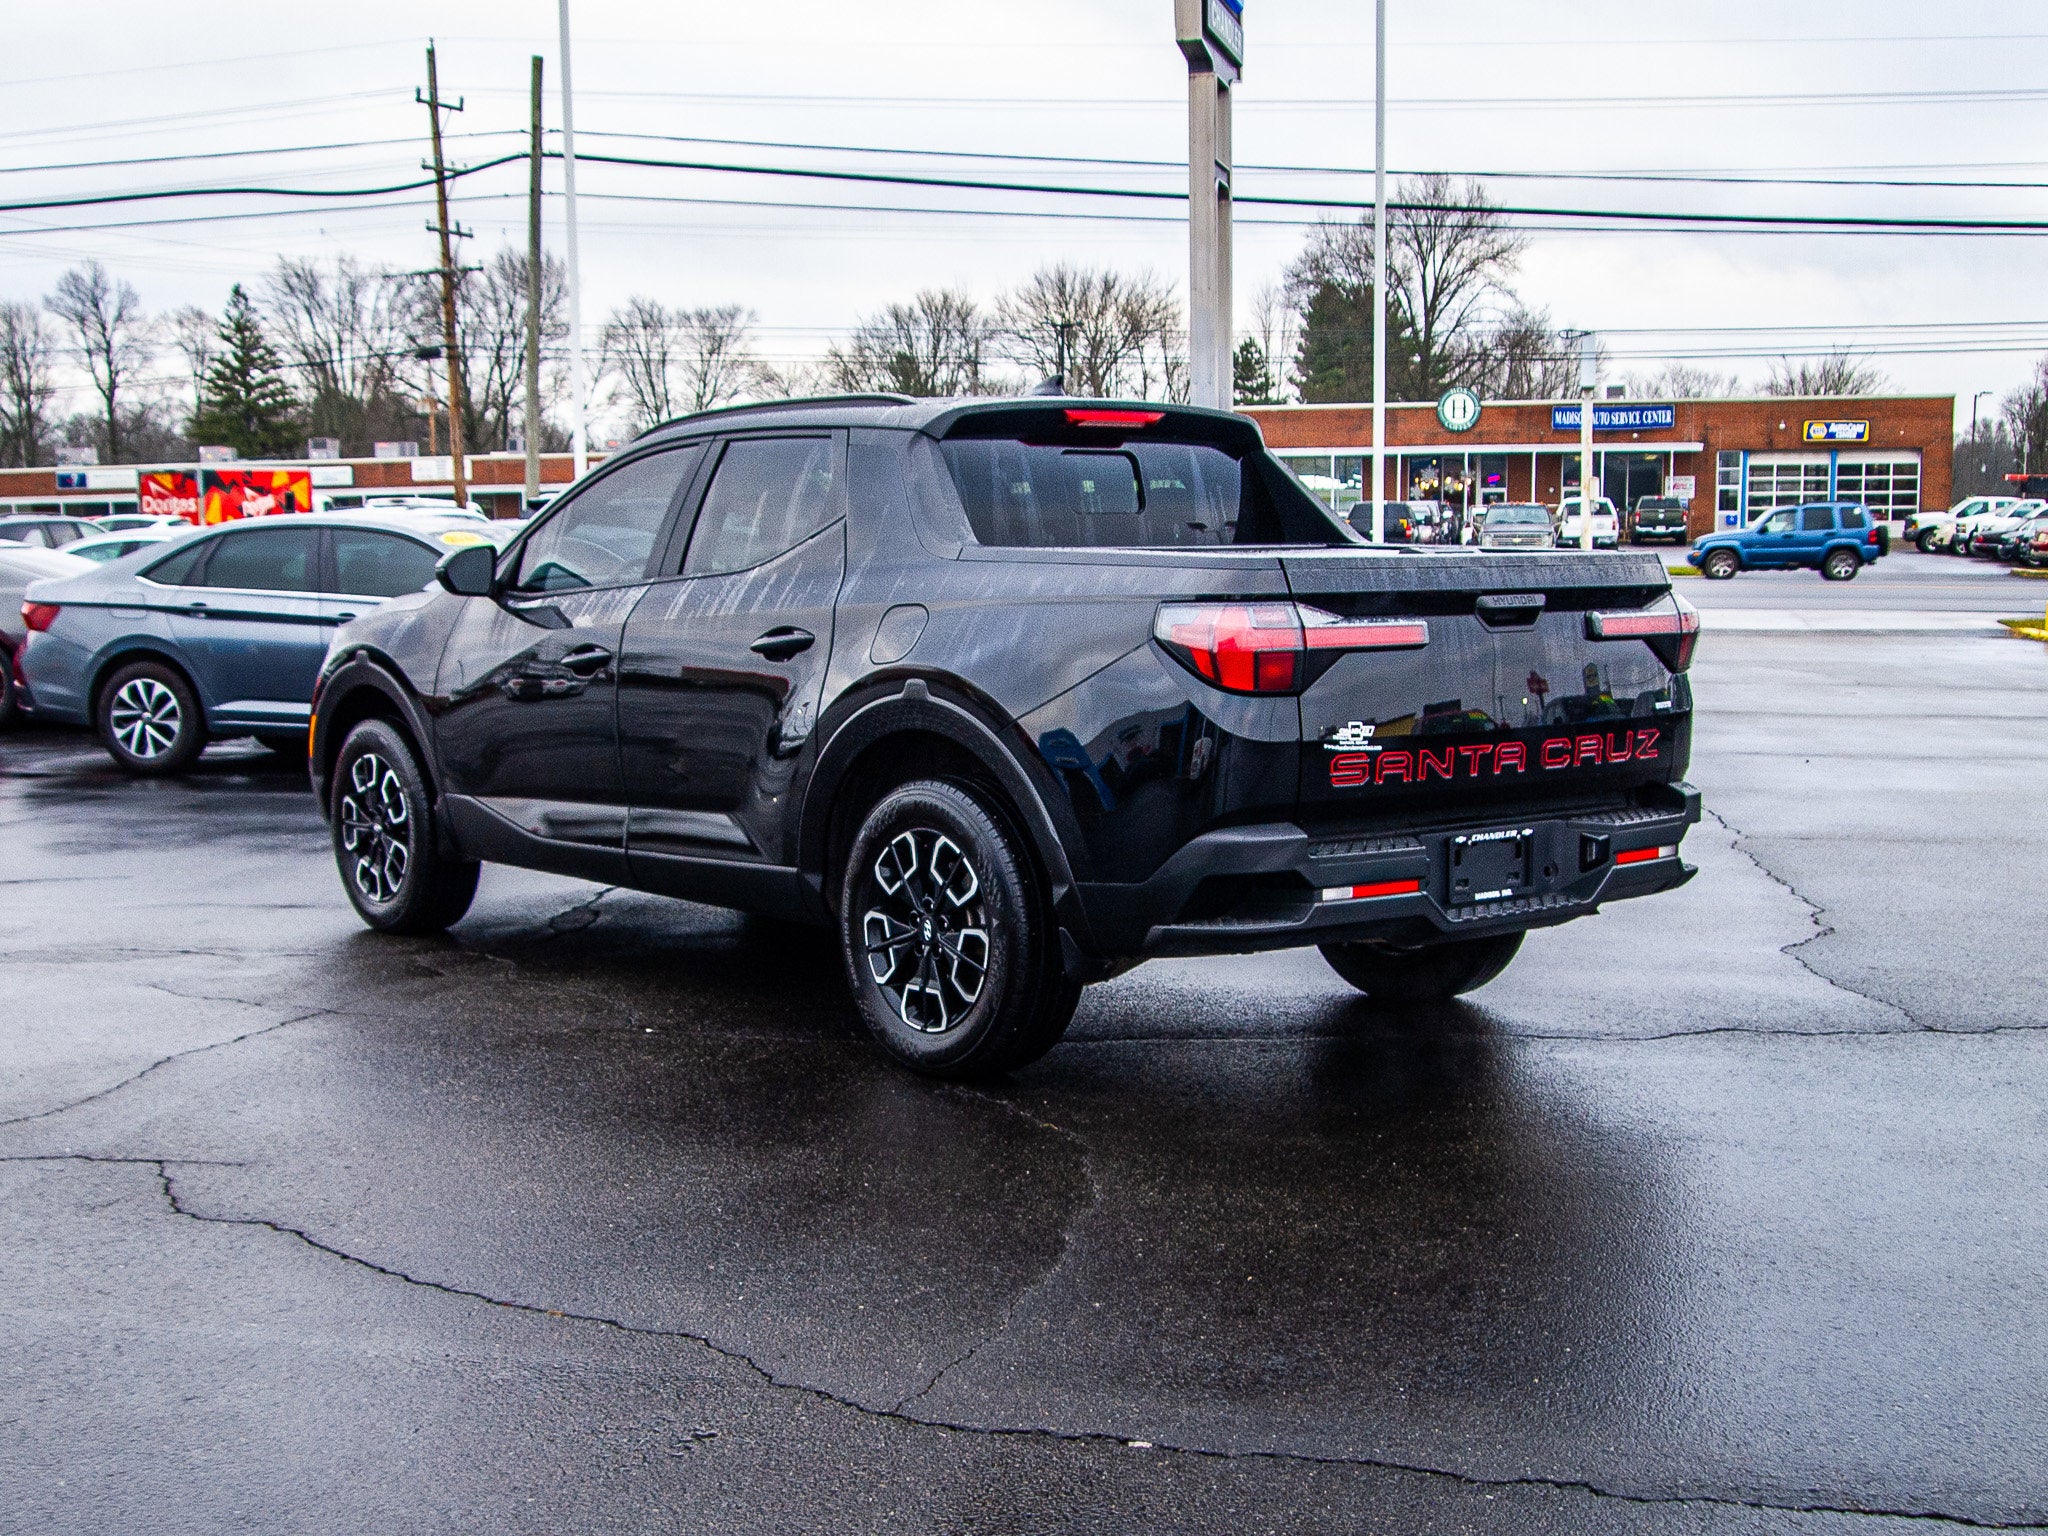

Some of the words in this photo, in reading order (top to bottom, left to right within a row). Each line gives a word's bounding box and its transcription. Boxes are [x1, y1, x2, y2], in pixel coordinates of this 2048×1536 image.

[1555, 410, 1582, 425] MADISO
[1611, 411, 1641, 425] SERVICE
[1642, 409, 1672, 424] CENTER
[142, 495, 197, 514] Doritos
[1492, 595, 1538, 606] HYUNDAI
[1330, 741, 1527, 788] SANTA
[1540, 728, 1661, 770] CRUZ
[1471, 829, 1519, 842] CHANDLER
